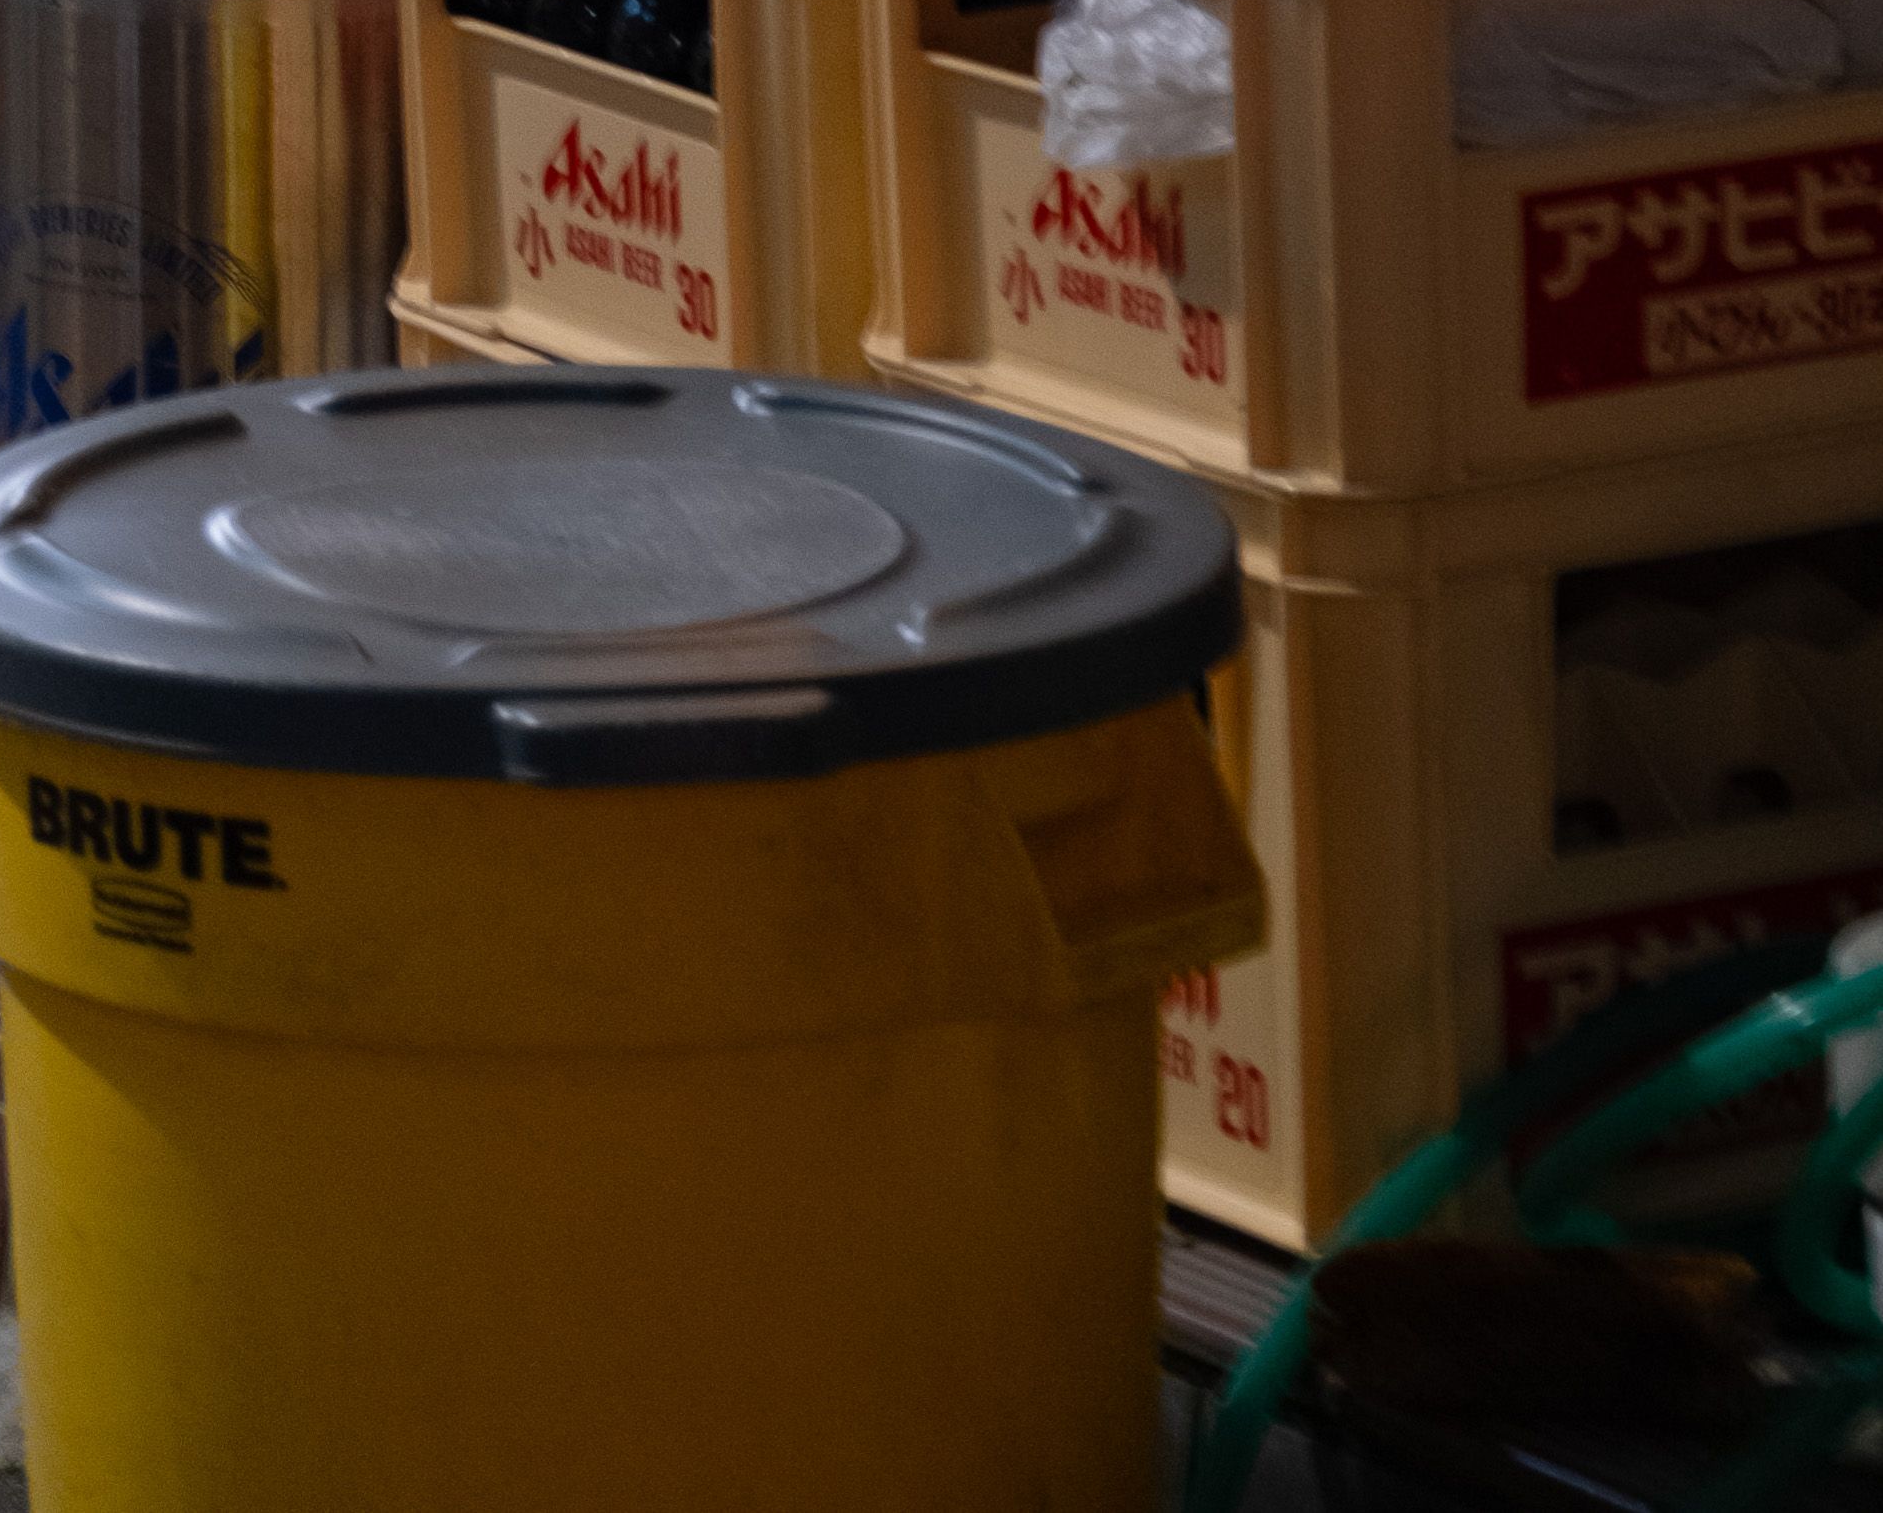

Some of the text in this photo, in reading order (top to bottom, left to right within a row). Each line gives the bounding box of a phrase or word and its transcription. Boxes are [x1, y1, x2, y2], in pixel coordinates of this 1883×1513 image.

[543, 117, 683, 247] Asahi
[1032, 163, 1184, 282] Asahi
[676, 261, 719, 342] 30
[1180, 299, 1228, 386] 30
[28, 773, 290, 891] BRUTE
[1214, 1049, 1270, 1151] 20
